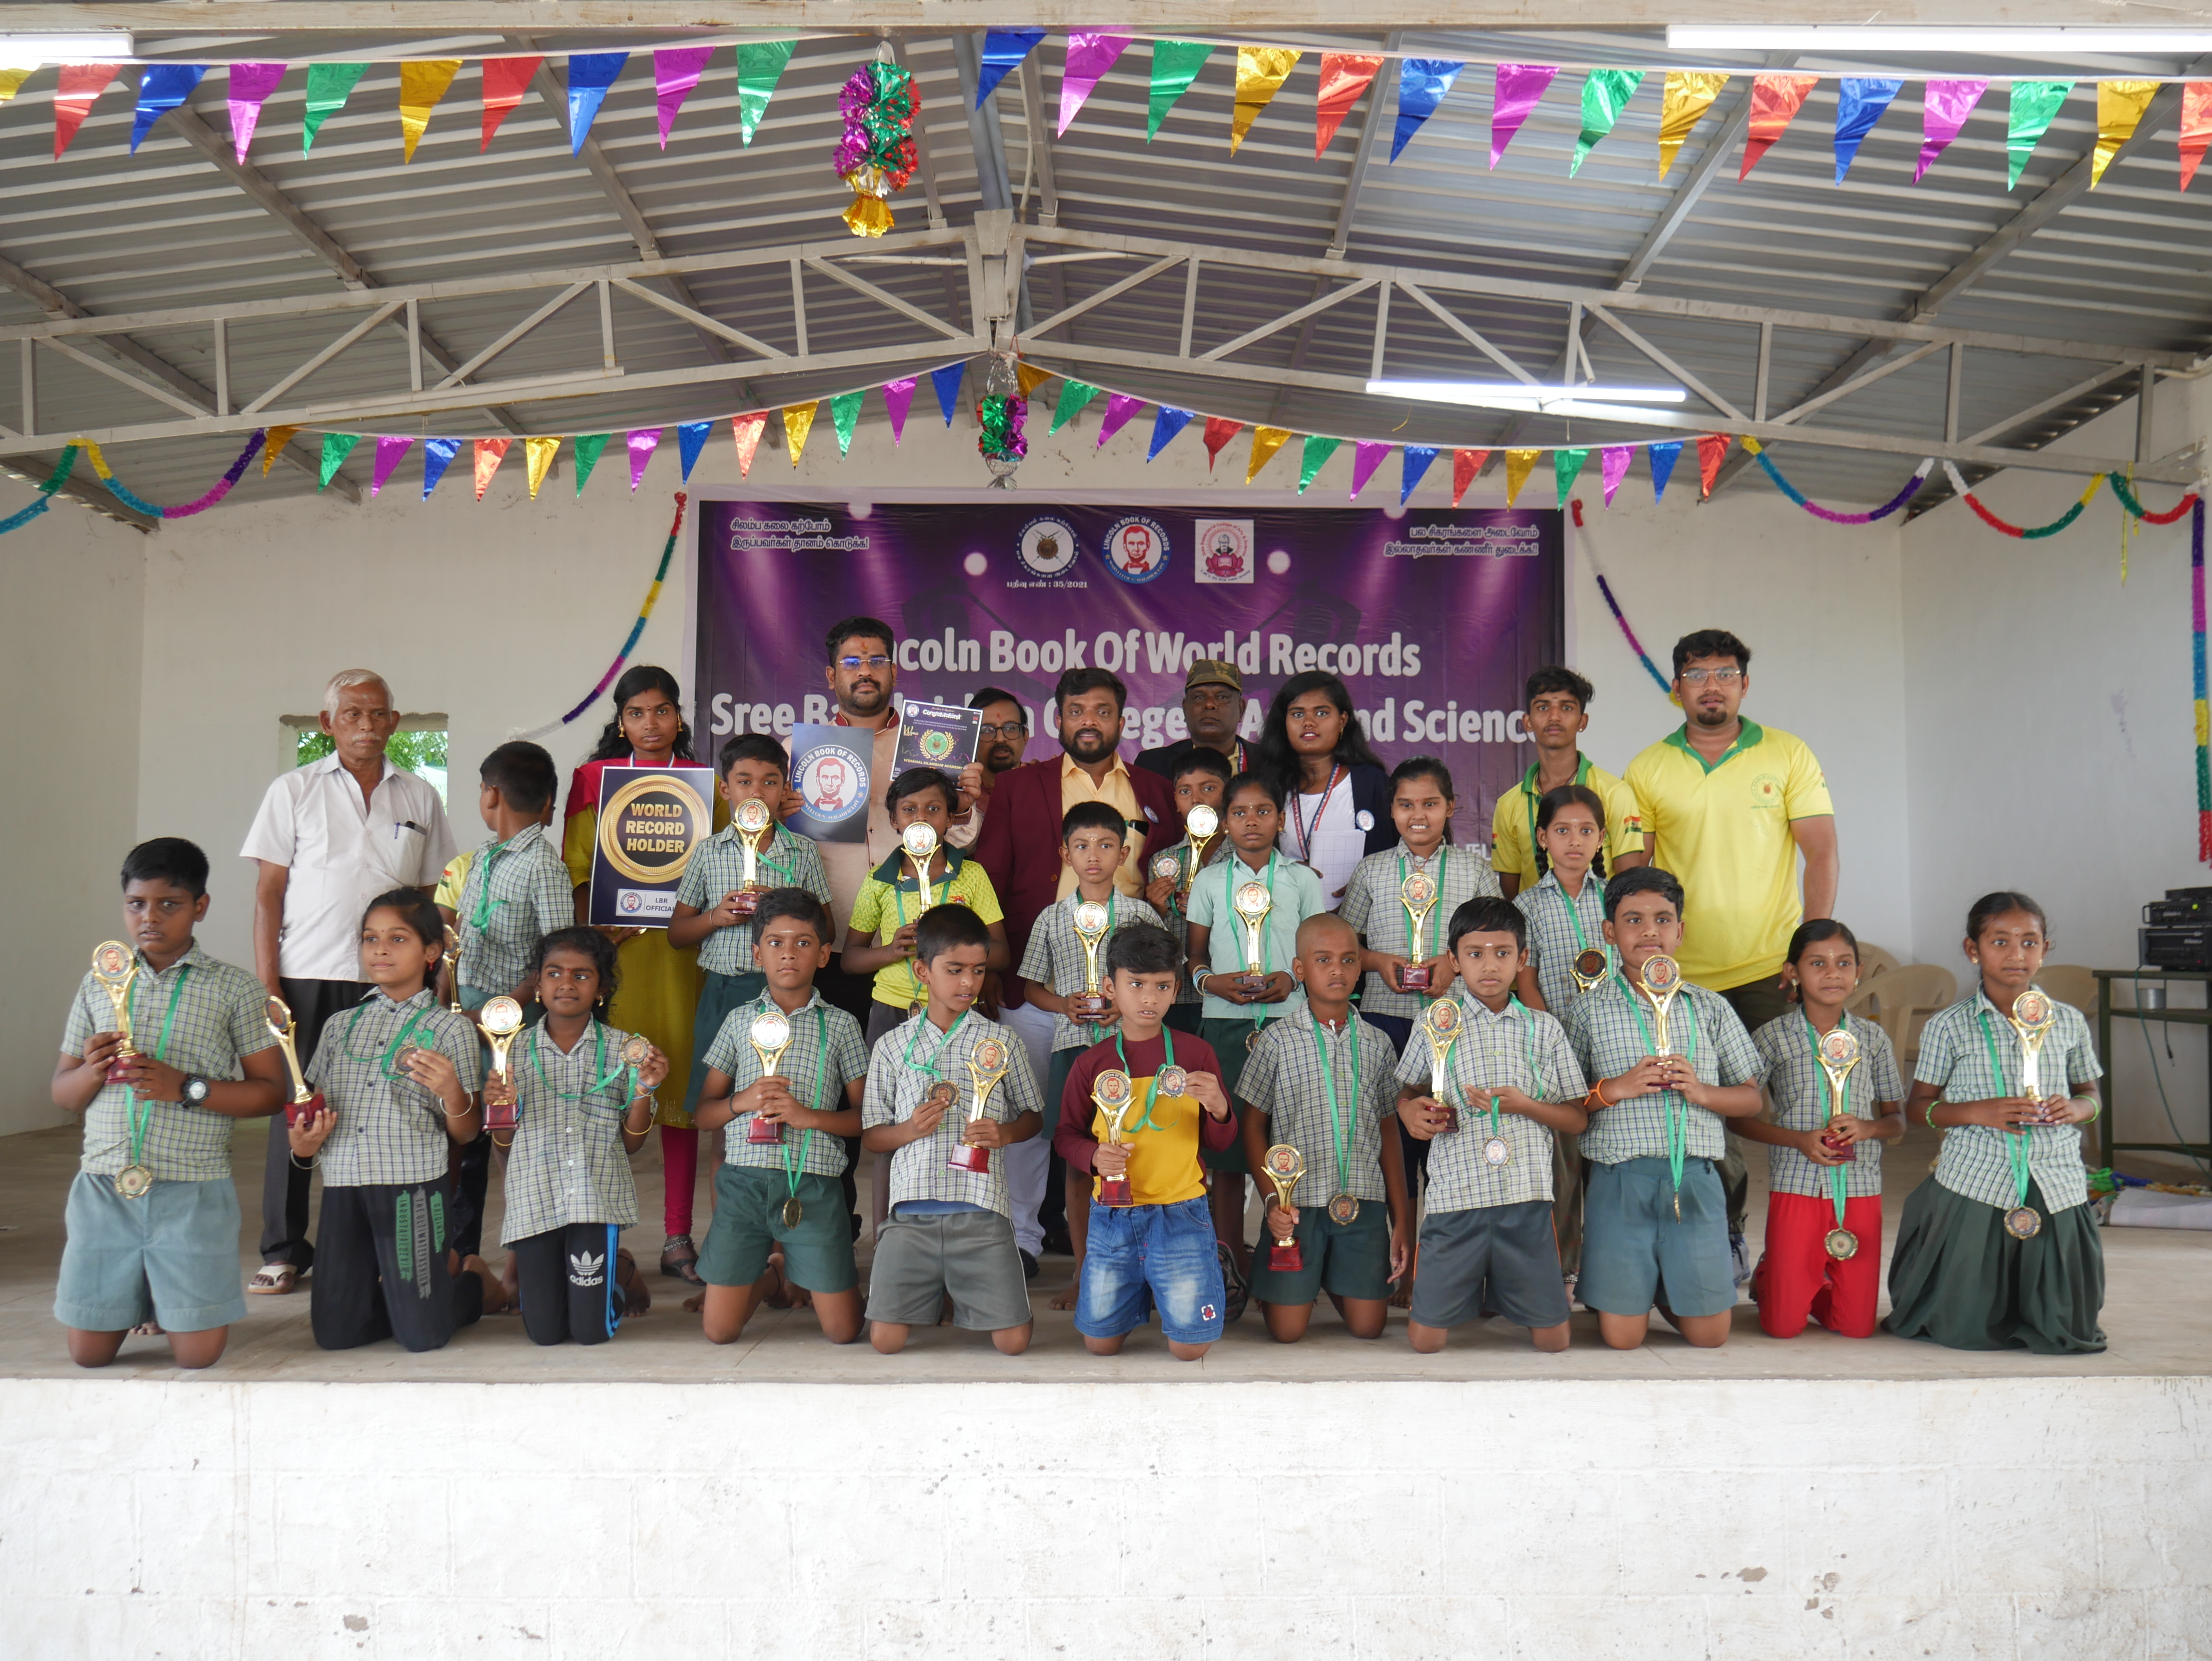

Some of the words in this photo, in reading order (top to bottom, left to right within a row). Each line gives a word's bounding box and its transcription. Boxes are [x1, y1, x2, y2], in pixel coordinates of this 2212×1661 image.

[731, 518, 761, 530] சிலம்ப
[764, 521, 789, 530] கலை
[790, 518, 830, 534] கற்போம்
[1104, 523, 1120, 550] LINCOLN
[1119, 516, 1140, 526] BOOK
[1150, 521, 1170, 551] RECORDS
[1410, 527, 1427, 538] பல
[1428, 525, 1483, 540] சிகரங்களை
[1484, 525, 1539, 538] அடைவோம்
[731, 535, 791, 549] இருப்பவர்கள்
[792, 535, 824, 551] தானம்
[1384, 541, 1452, 558] இல்லாதவர்கள்
[1053, 580, 1088, 589] 35/2021
[990, 628, 1087, 672] Book
[1094, 629, 1141, 673] Of
[1145, 630, 1261, 675] World
[1269, 631, 1422, 676] Records
[711, 693, 795, 736] Sree
[1403, 699, 1536, 743] Scienc
[794, 753, 815, 783] LINCOLN
[814, 747, 836, 758] BOOK
[837, 749, 848, 757] OF
[846, 754, 866, 788] RECORDS
[631, 803, 683, 818] WORLD
[625, 820, 685, 836] RECORD
[626, 838, 685, 853] HOLDER
[569, 1274, 604, 1287] adidas
